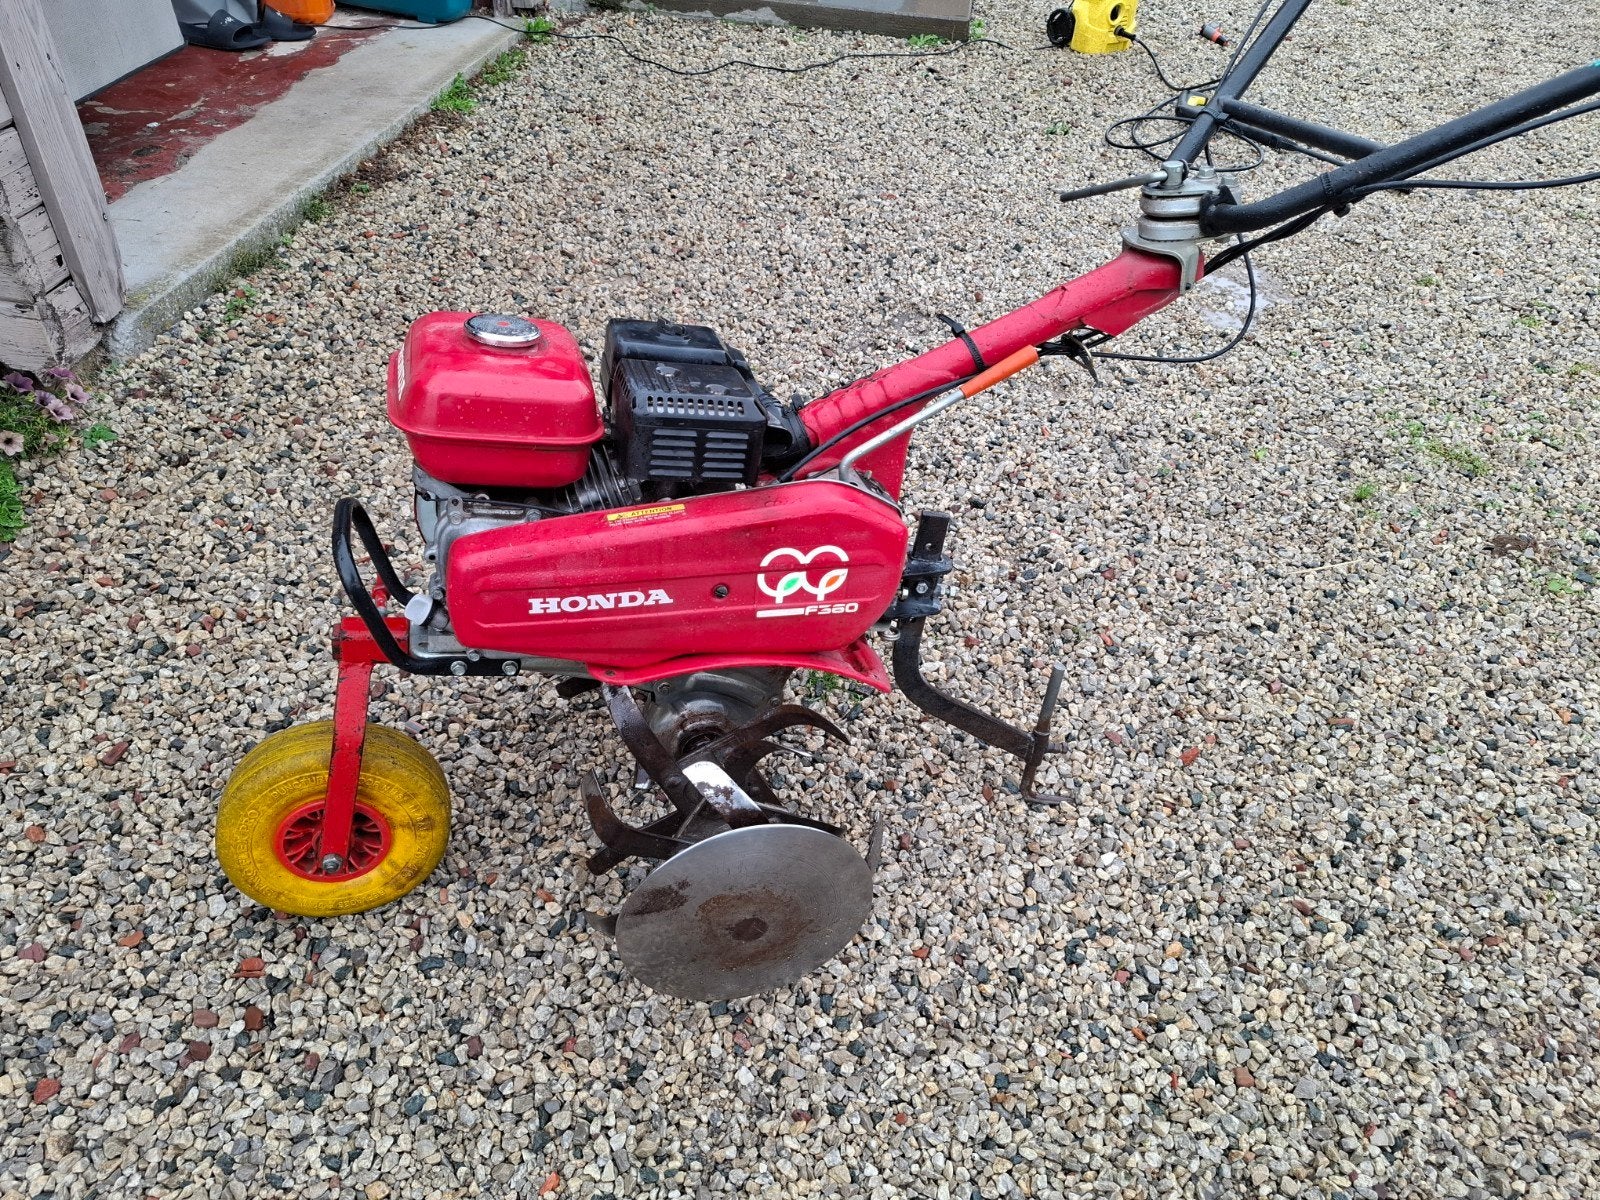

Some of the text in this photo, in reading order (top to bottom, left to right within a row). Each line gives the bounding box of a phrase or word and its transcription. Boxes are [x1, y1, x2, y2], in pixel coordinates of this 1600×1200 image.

[631, 502, 672, 516] ATTENTION
[528, 588, 674, 614] HONDA
[804, 602, 859, 616] F360
